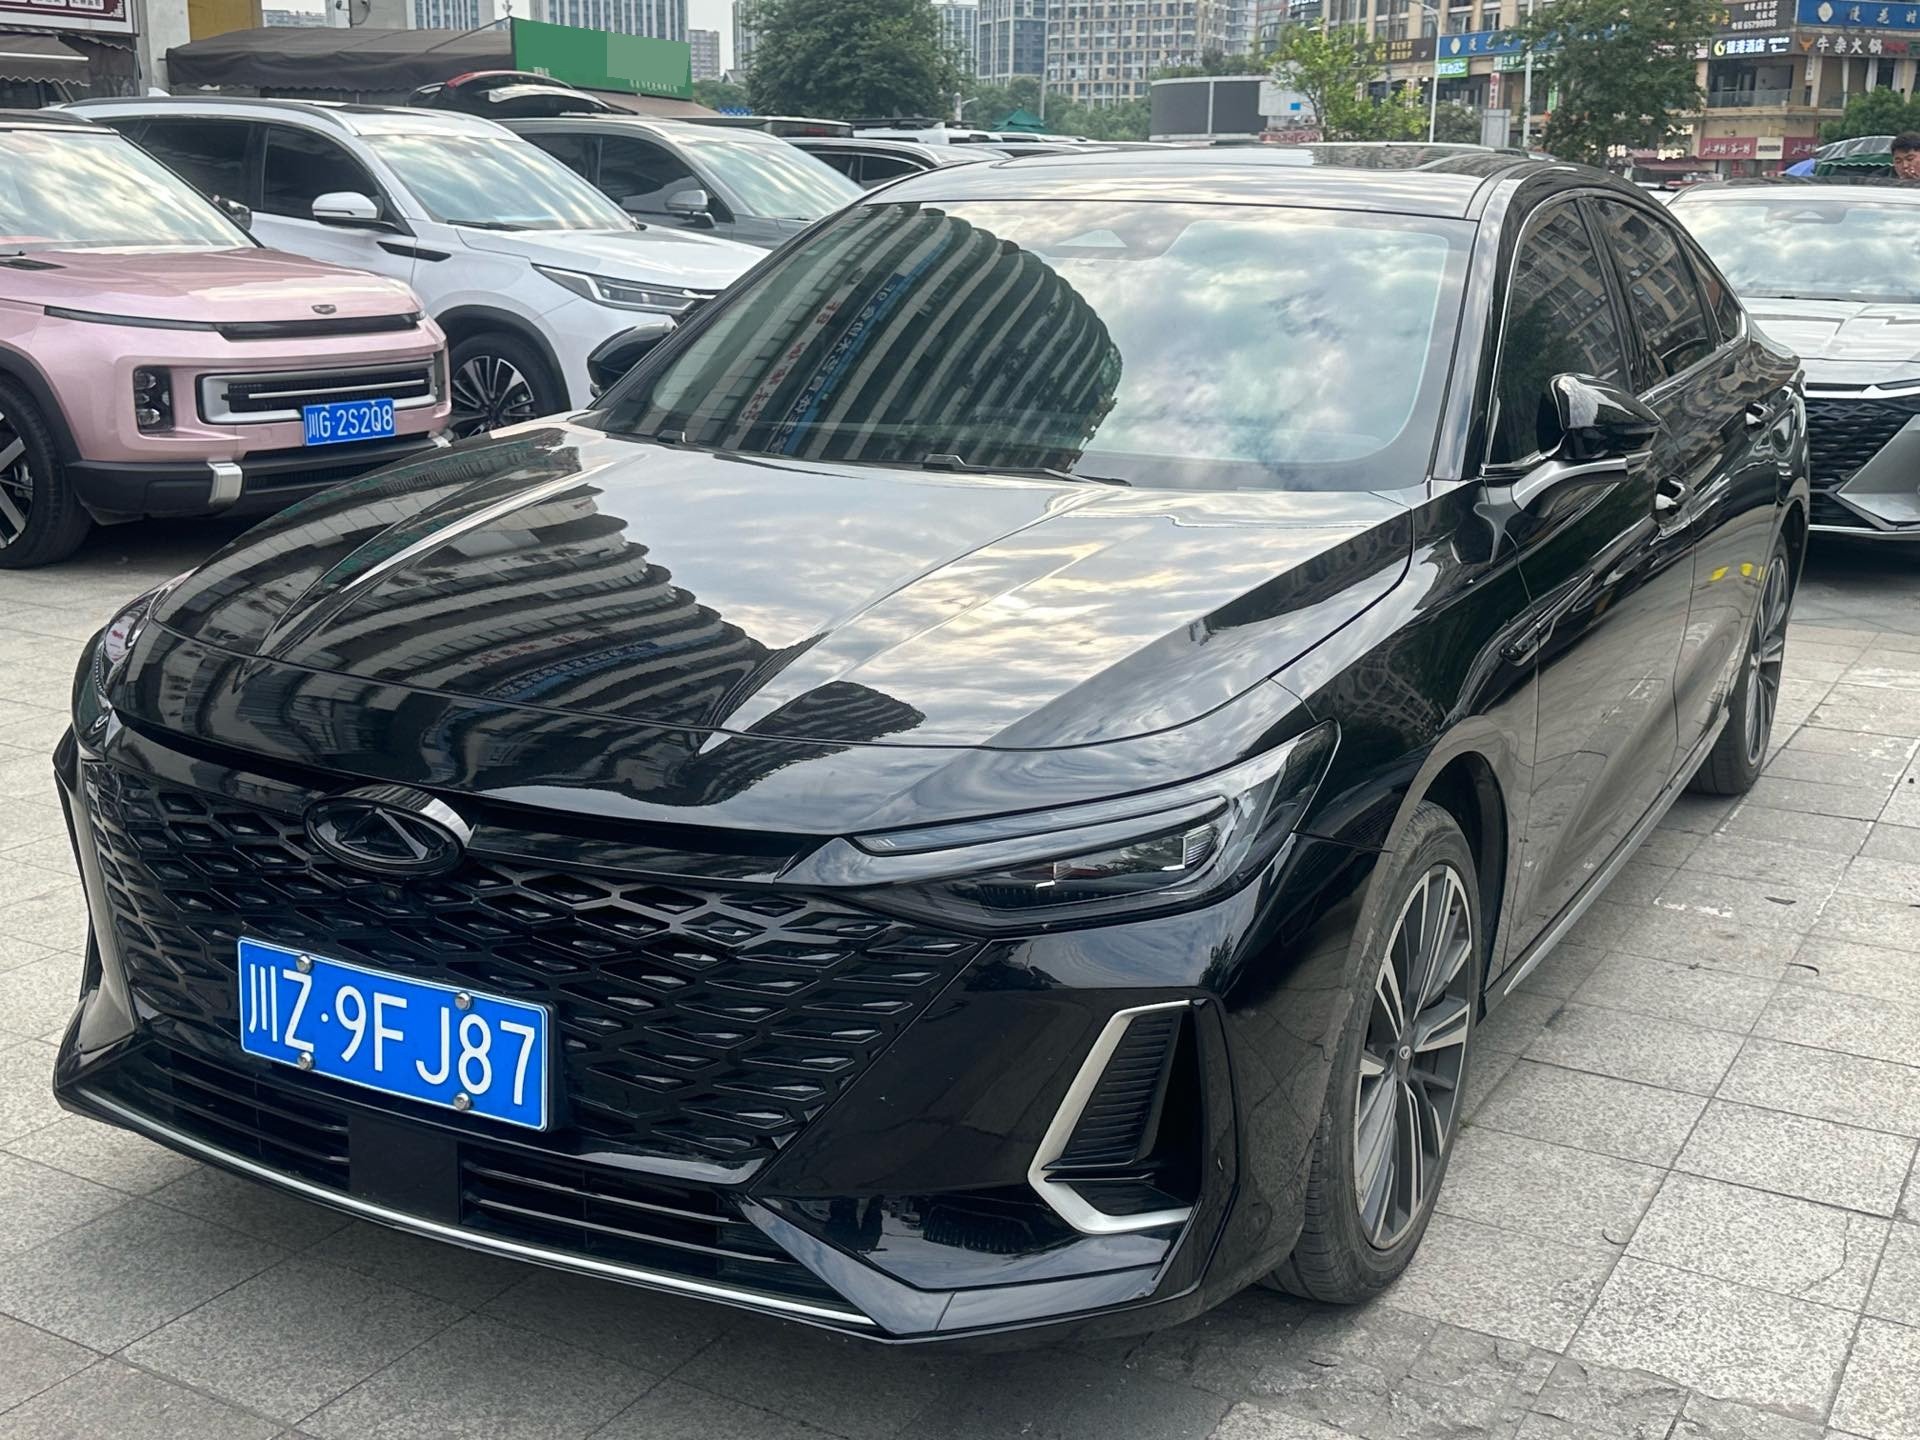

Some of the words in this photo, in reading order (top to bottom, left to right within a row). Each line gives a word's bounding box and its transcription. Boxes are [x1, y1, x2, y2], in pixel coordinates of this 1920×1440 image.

[1817, 35, 1883, 55] 牛杂火锅
[308, 405, 393, 439] 川G·2S2Q8
[248, 963, 536, 1106] 川Z·9FJ87
